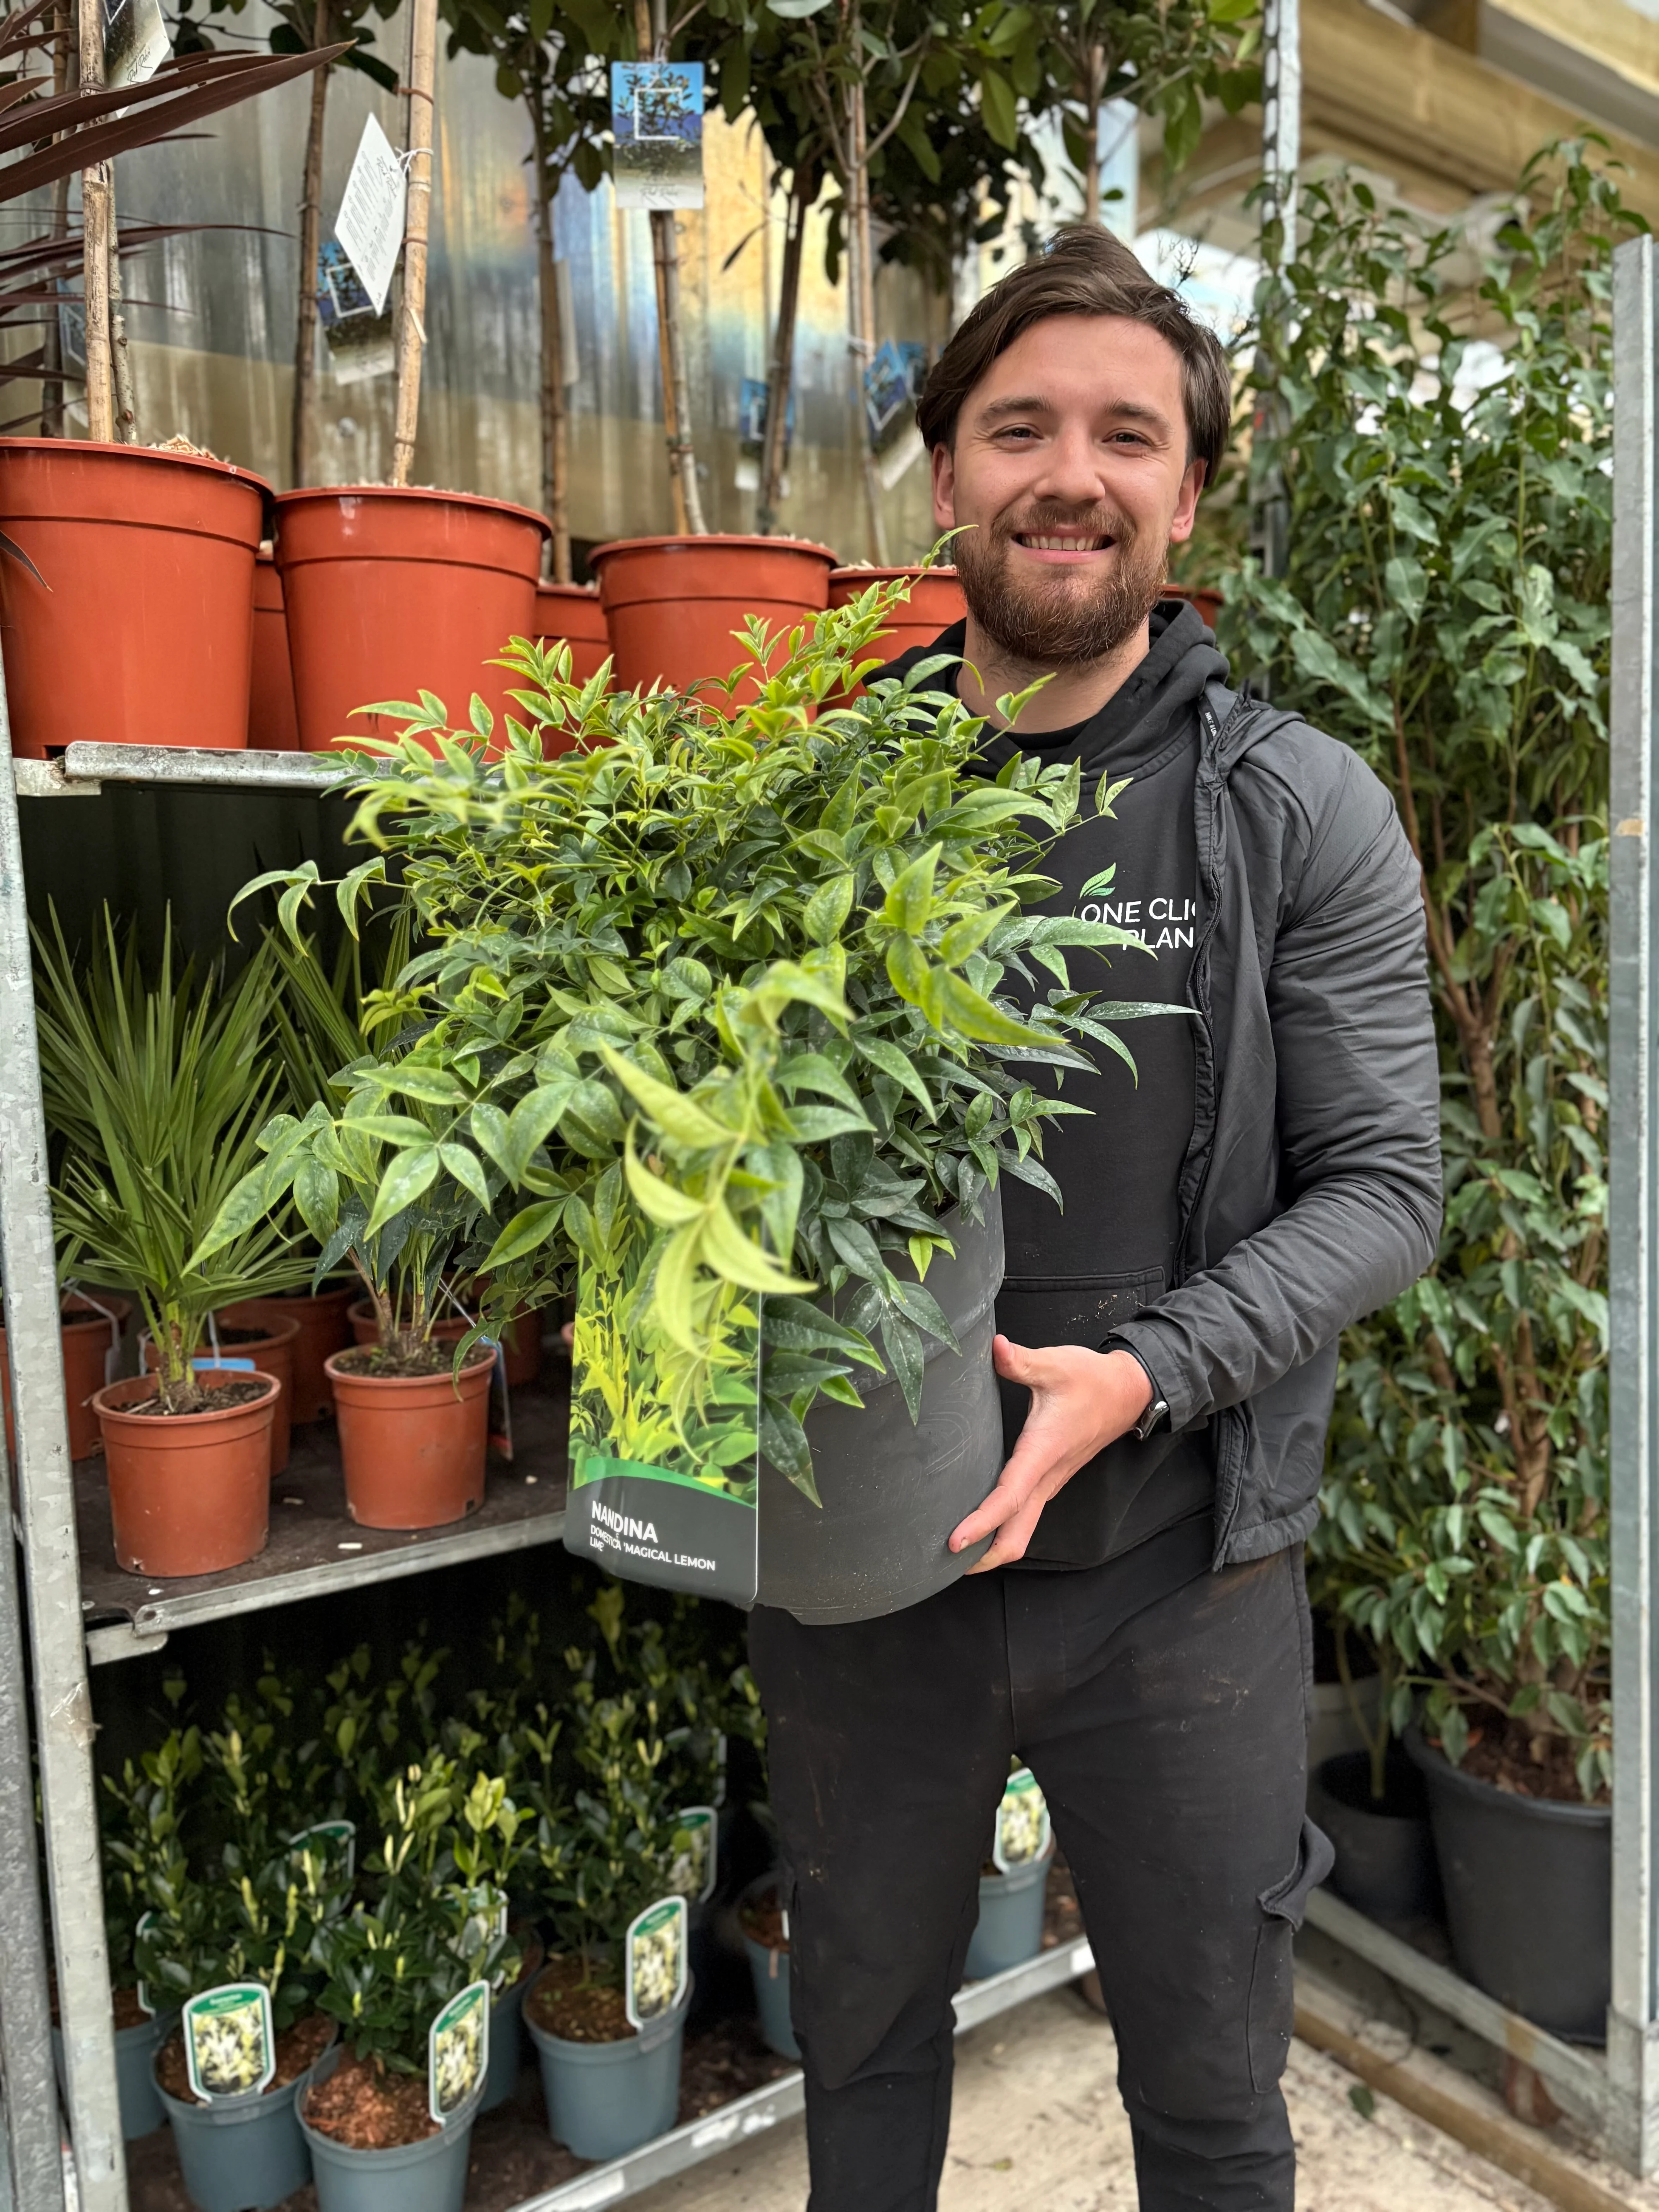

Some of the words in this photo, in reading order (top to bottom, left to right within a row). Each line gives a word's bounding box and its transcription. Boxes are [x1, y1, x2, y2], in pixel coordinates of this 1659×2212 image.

[1205, 712, 1214, 725] NIKE
[1081, 900, 1142, 924] ONE
[1149, 897, 1195, 921] CLI
[592, 1500, 658, 1543] NANDINA
[674, 1554, 715, 1571] LEMON
